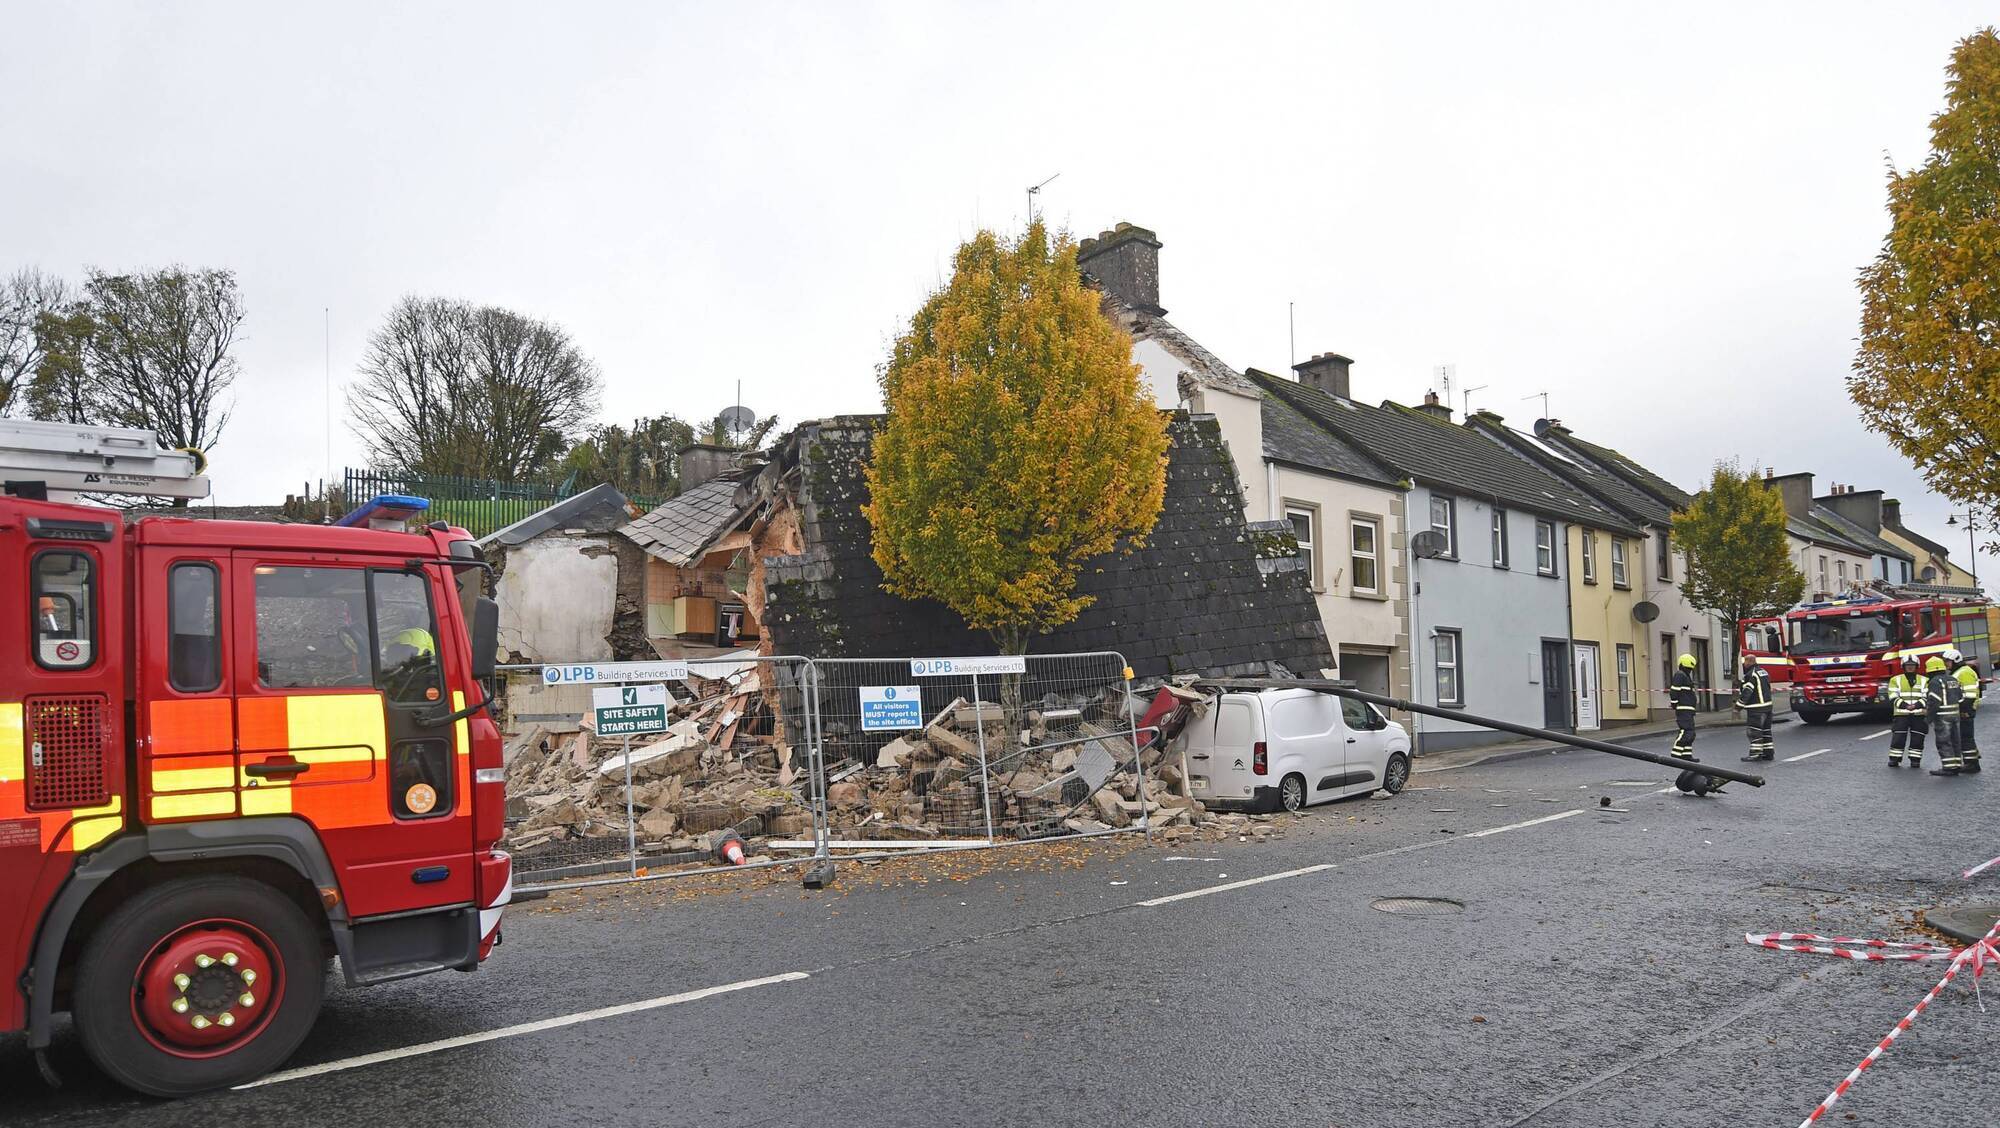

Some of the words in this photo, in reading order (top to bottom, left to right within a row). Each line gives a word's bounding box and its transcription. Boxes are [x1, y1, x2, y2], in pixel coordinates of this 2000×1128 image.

[928, 661, 952, 674] LPB
[954, 665, 982, 673] Building
[983, 664, 1010, 672] Services
[1011, 663, 1023, 671] LTD
[564, 667, 594, 681] LPB
[597, 671, 633, 680] Building
[634, 670, 668, 679] Services
[670, 668, 685, 677] LTD
[603, 709, 624, 719] SITE
[625, 707, 659, 718] SAFETY
[601, 721, 635, 732] STARTS
[636, 720, 663, 730] HERE!
